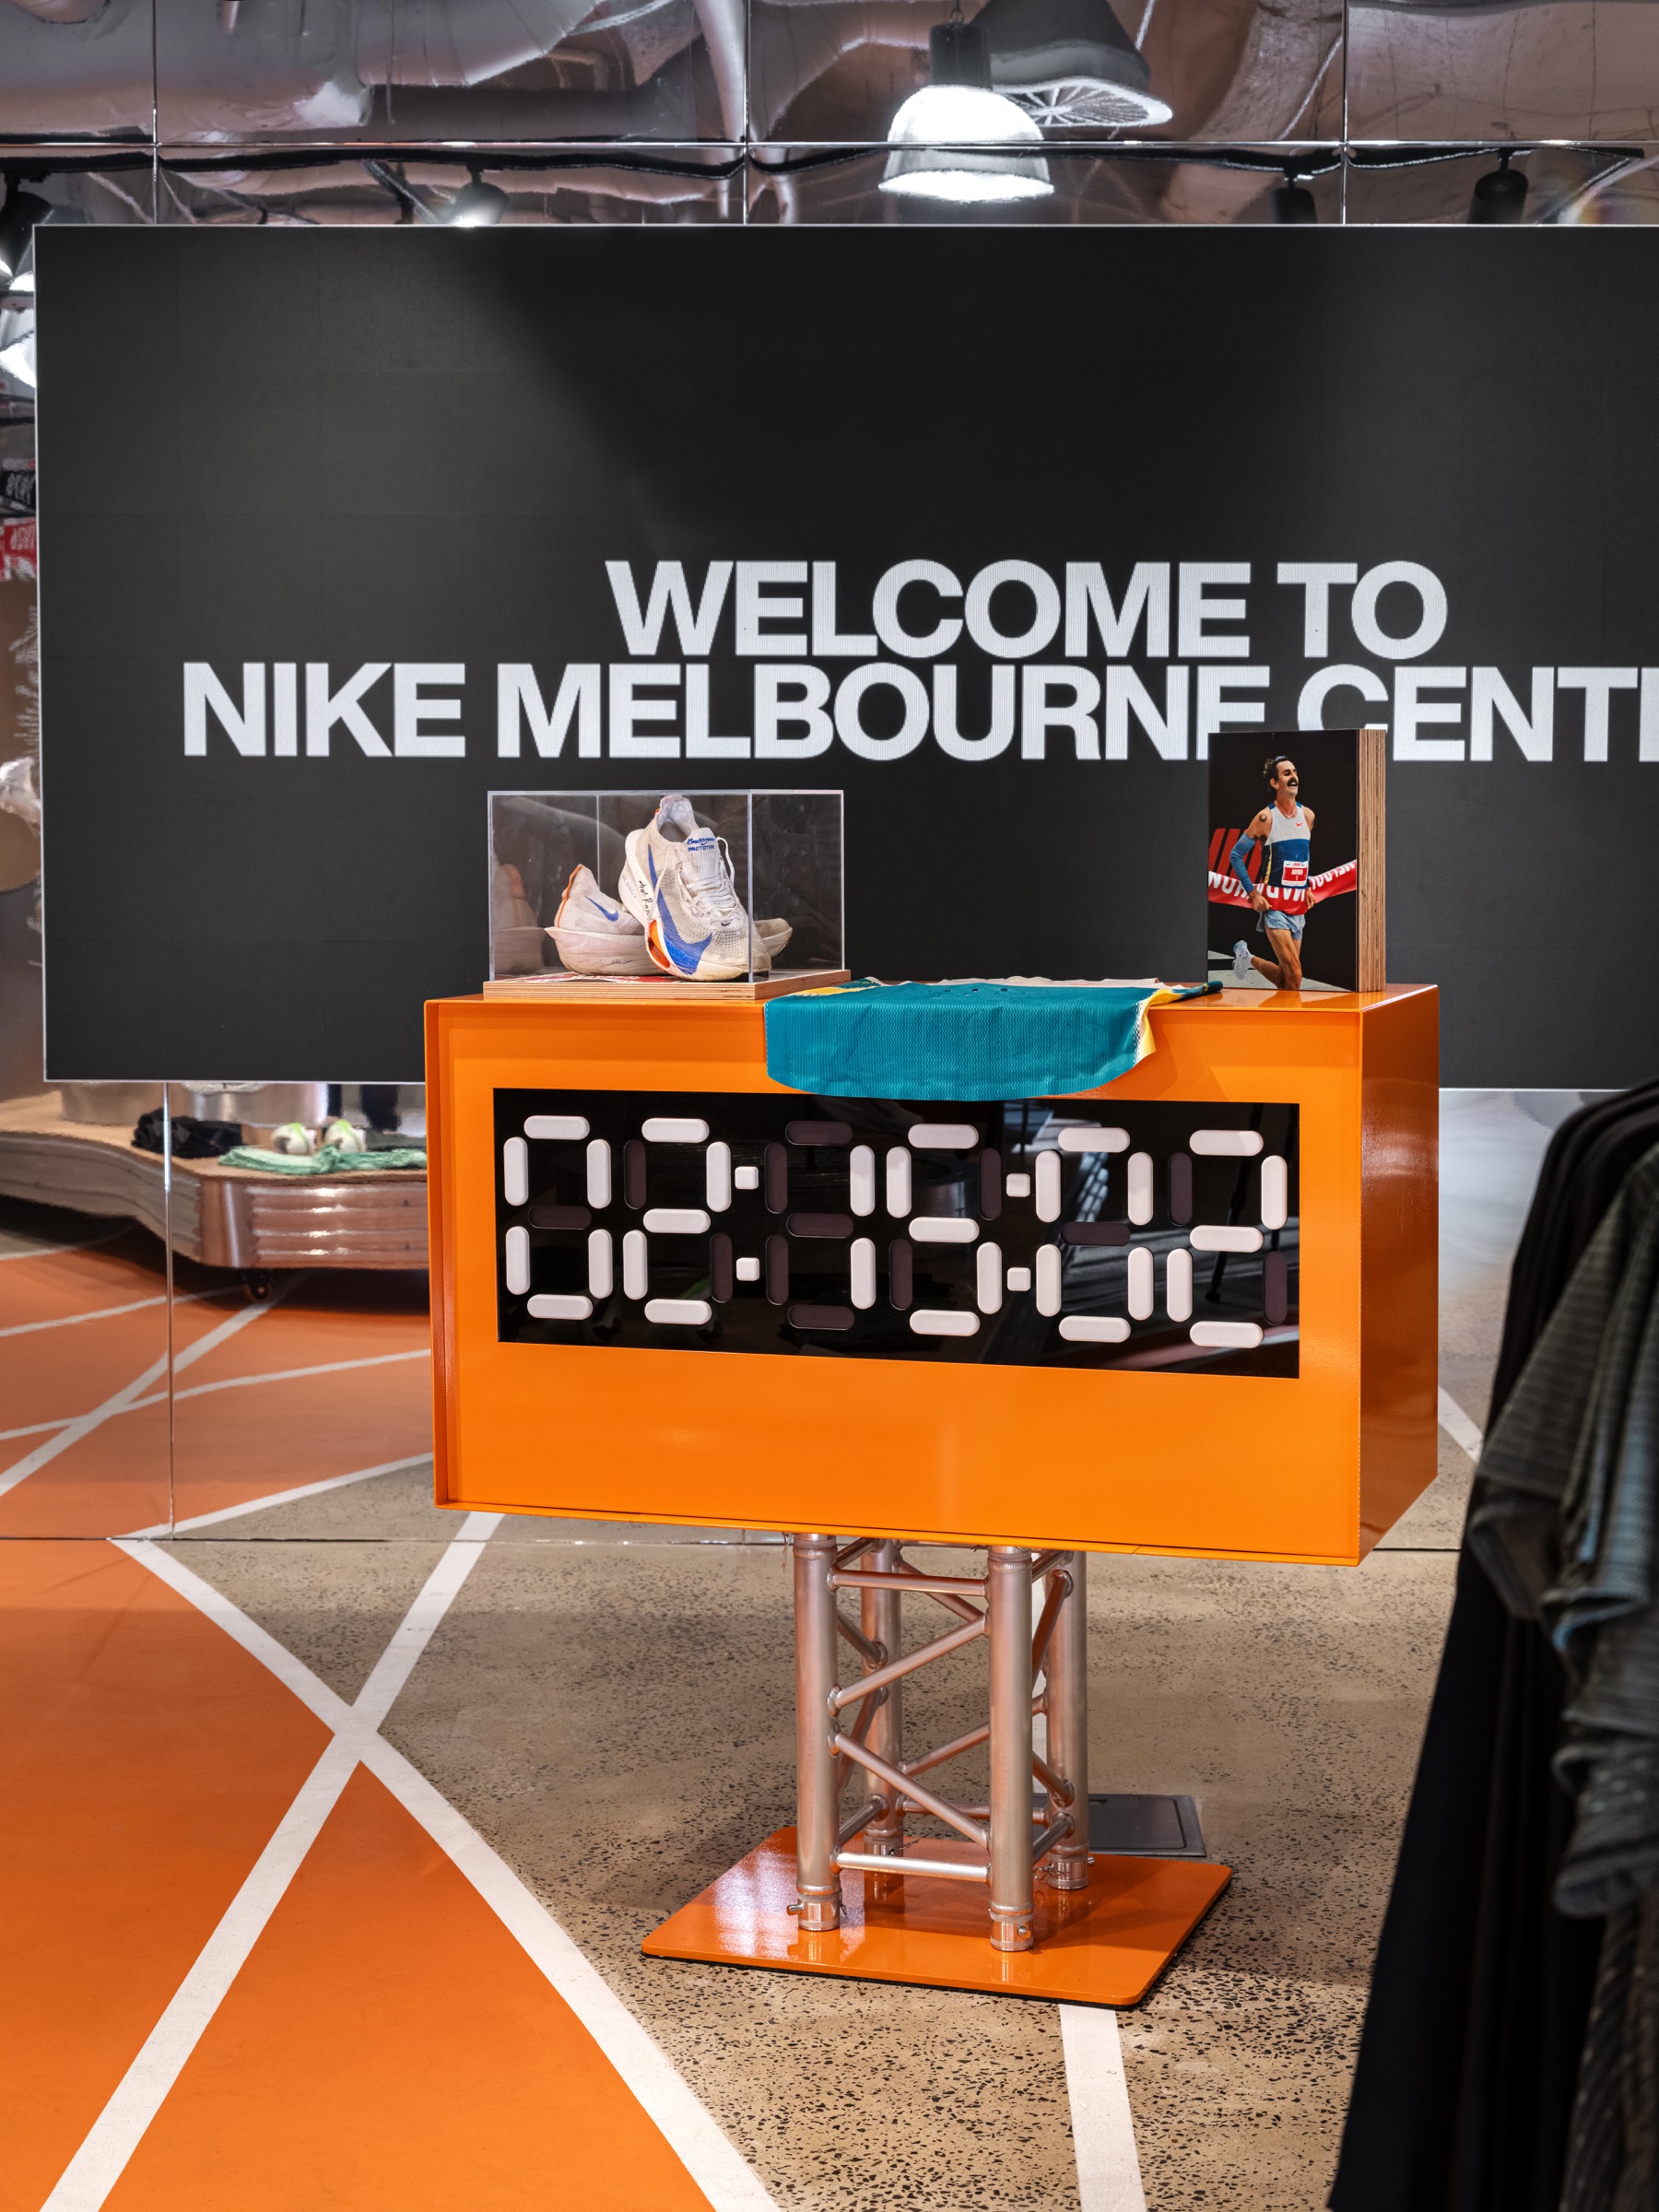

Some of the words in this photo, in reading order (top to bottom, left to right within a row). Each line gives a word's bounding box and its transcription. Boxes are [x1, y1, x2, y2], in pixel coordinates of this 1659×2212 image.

[606, 559, 1251, 659] WELCOME
[1277, 560, 1448, 660] TO
[183, 662, 466, 758] NIKE
[497, 662, 1270, 761] MELBOURNE
[503, 1115, 1288, 1348] 02:15:02
